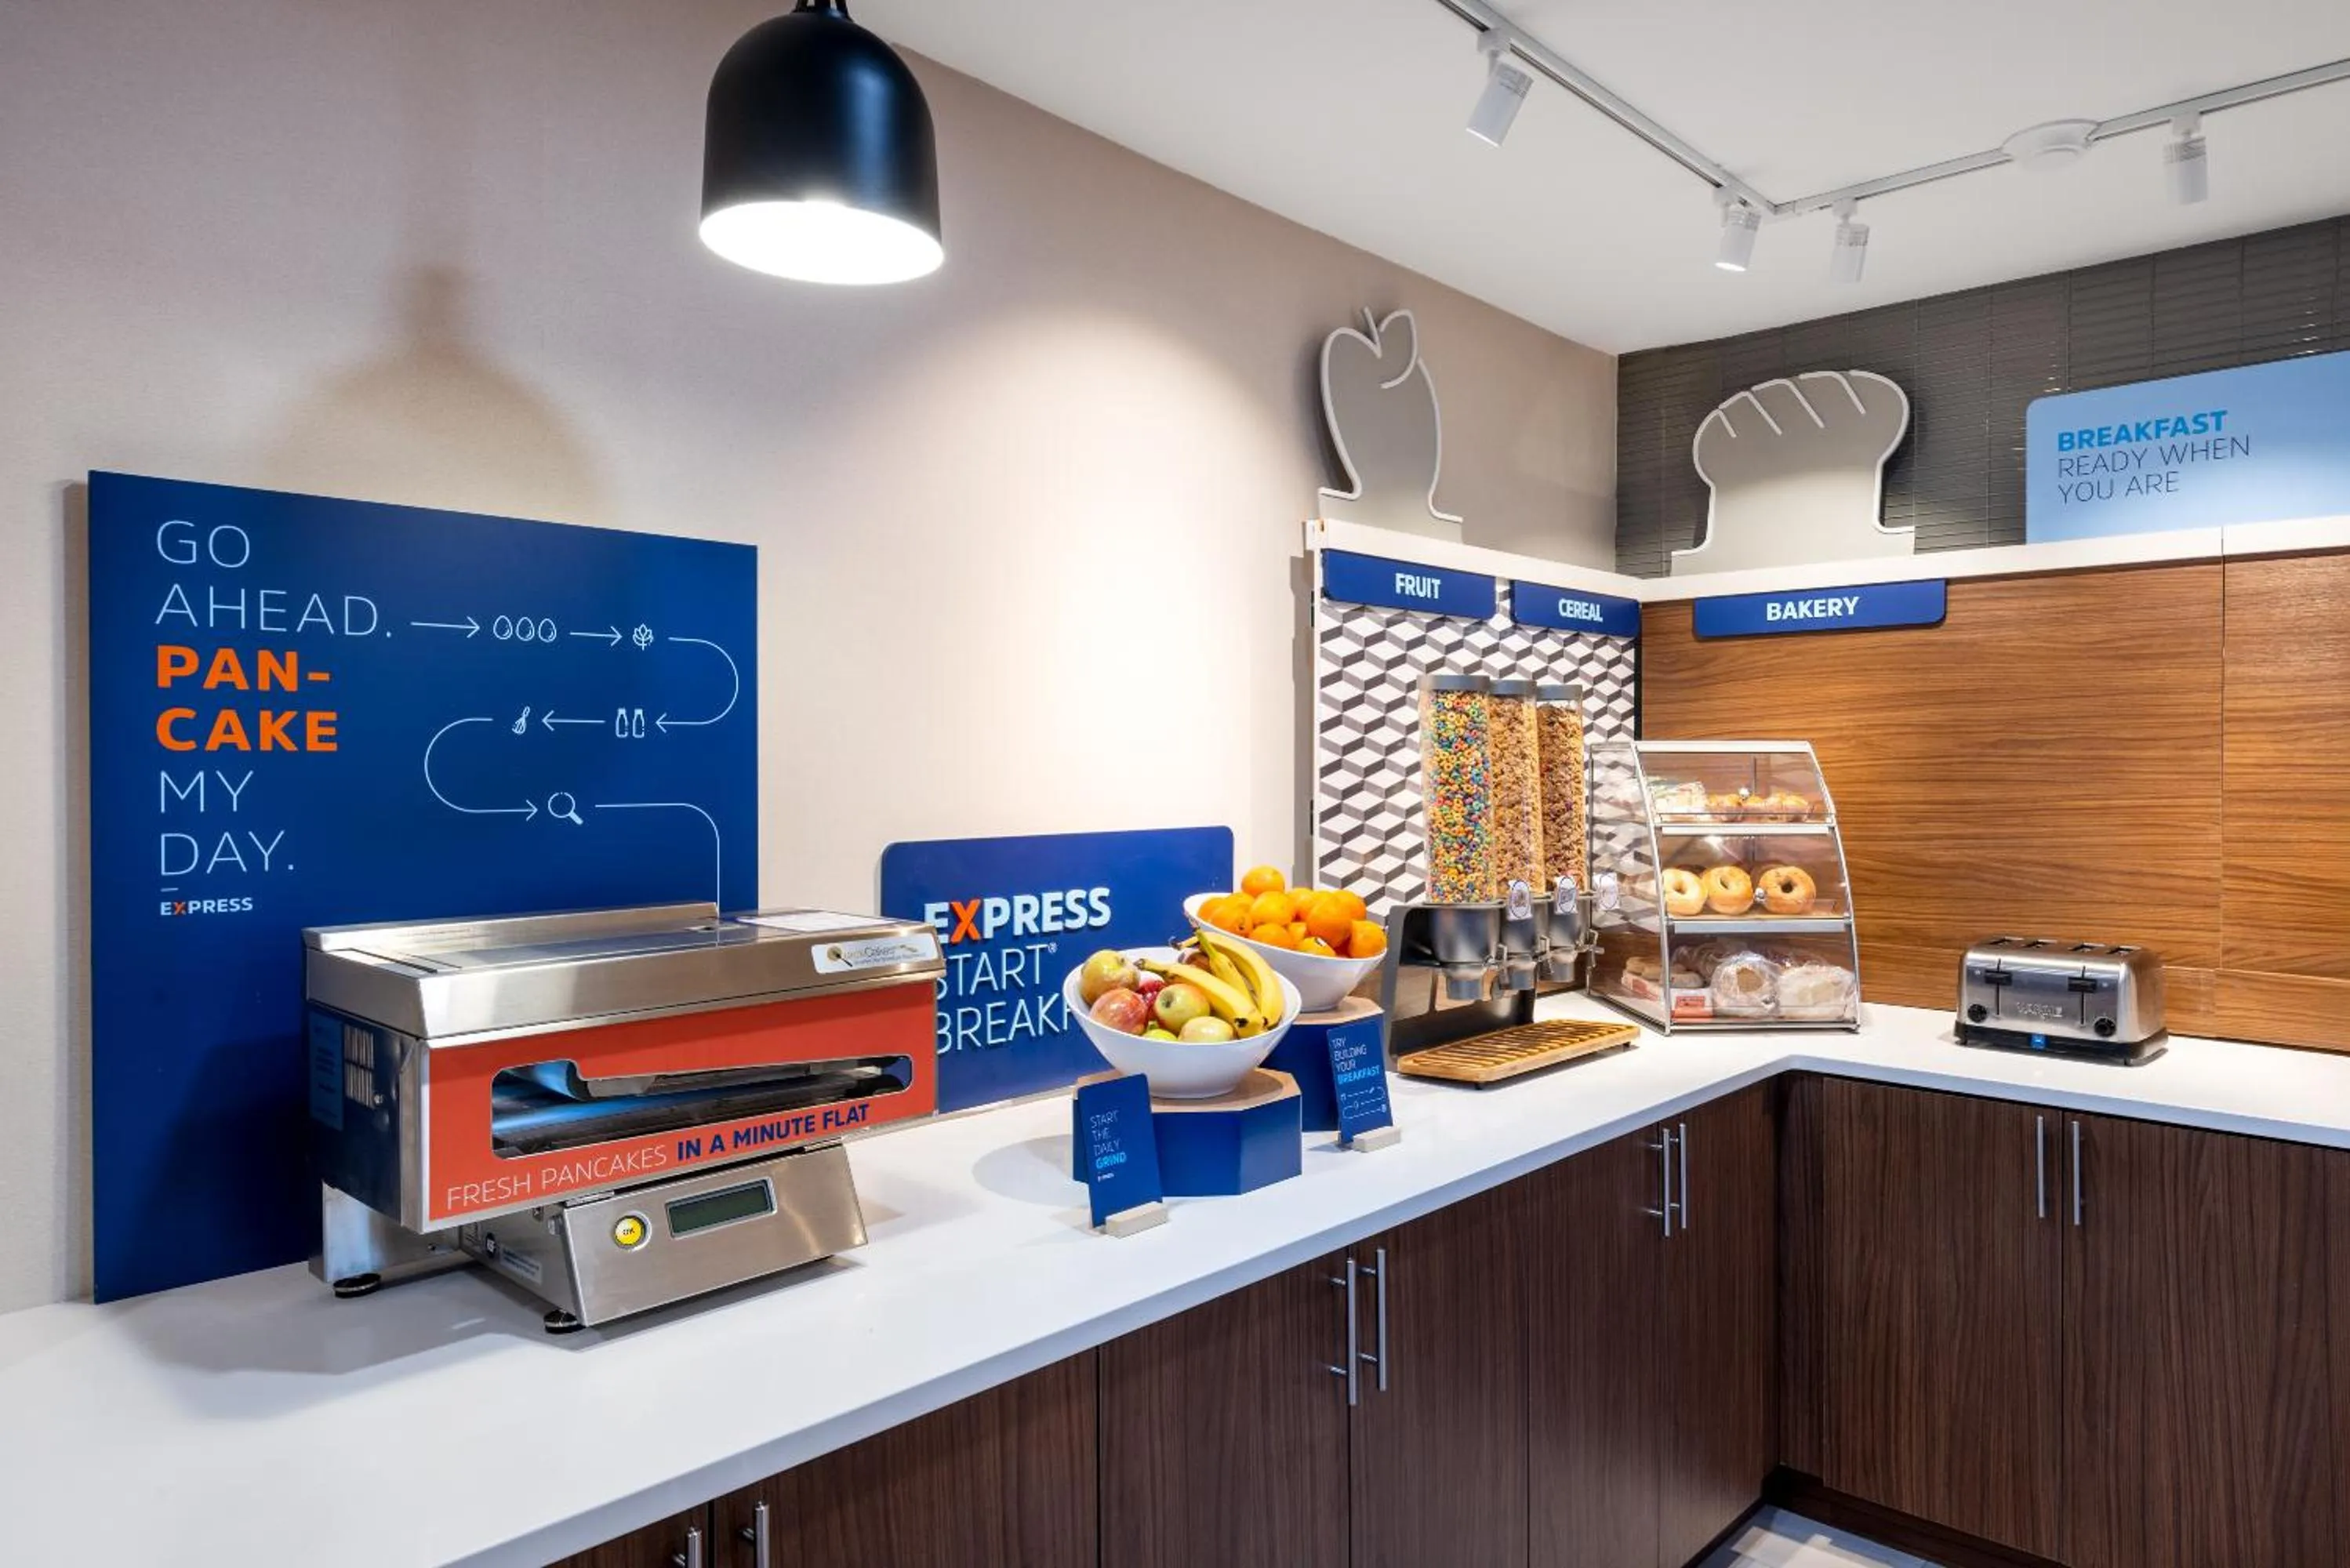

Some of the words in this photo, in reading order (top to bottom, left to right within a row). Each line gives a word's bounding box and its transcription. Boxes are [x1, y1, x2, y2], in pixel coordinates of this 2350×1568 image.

[2058, 409, 2228, 452] BREAKFAST
[2058, 447, 2148, 478] READY
[2159, 434, 2250, 466] WHEN
[2058, 478, 2115, 506] YOU
[2125, 471, 2180, 499] ARE
[156, 519, 251, 569] GO
[1394, 572, 1442, 600] FRUIT
[155, 583, 393, 638] AHEAD.
[1557, 597, 1604, 622] CEREAL
[1766, 596, 1861, 622] BAKERY
[156, 644, 331, 692] PAN-
[156, 707, 339, 753] CAKE
[159, 770, 254, 814] MY
[160, 830, 294, 877] DAY.
[160, 897, 253, 916] EXPRESS
[924, 887, 1112, 945] EXPRESS
[1335, 1058, 1357, 1073] YOUR
[1337, 1065, 1381, 1084] BREAKFAST
[1090, 1109, 1120, 1129] START
[447, 1172, 531, 1210] FRESH
[541, 1144, 667, 1190] PANCAKES
[677, 1138, 702, 1161] IN
[709, 1134, 725, 1154] A
[733, 1114, 816, 1149] MINUTE
[823, 1103, 870, 1130] FLAT
[1095, 1151, 1128, 1170] GRIND
[622, 1226, 636, 1236] OK
